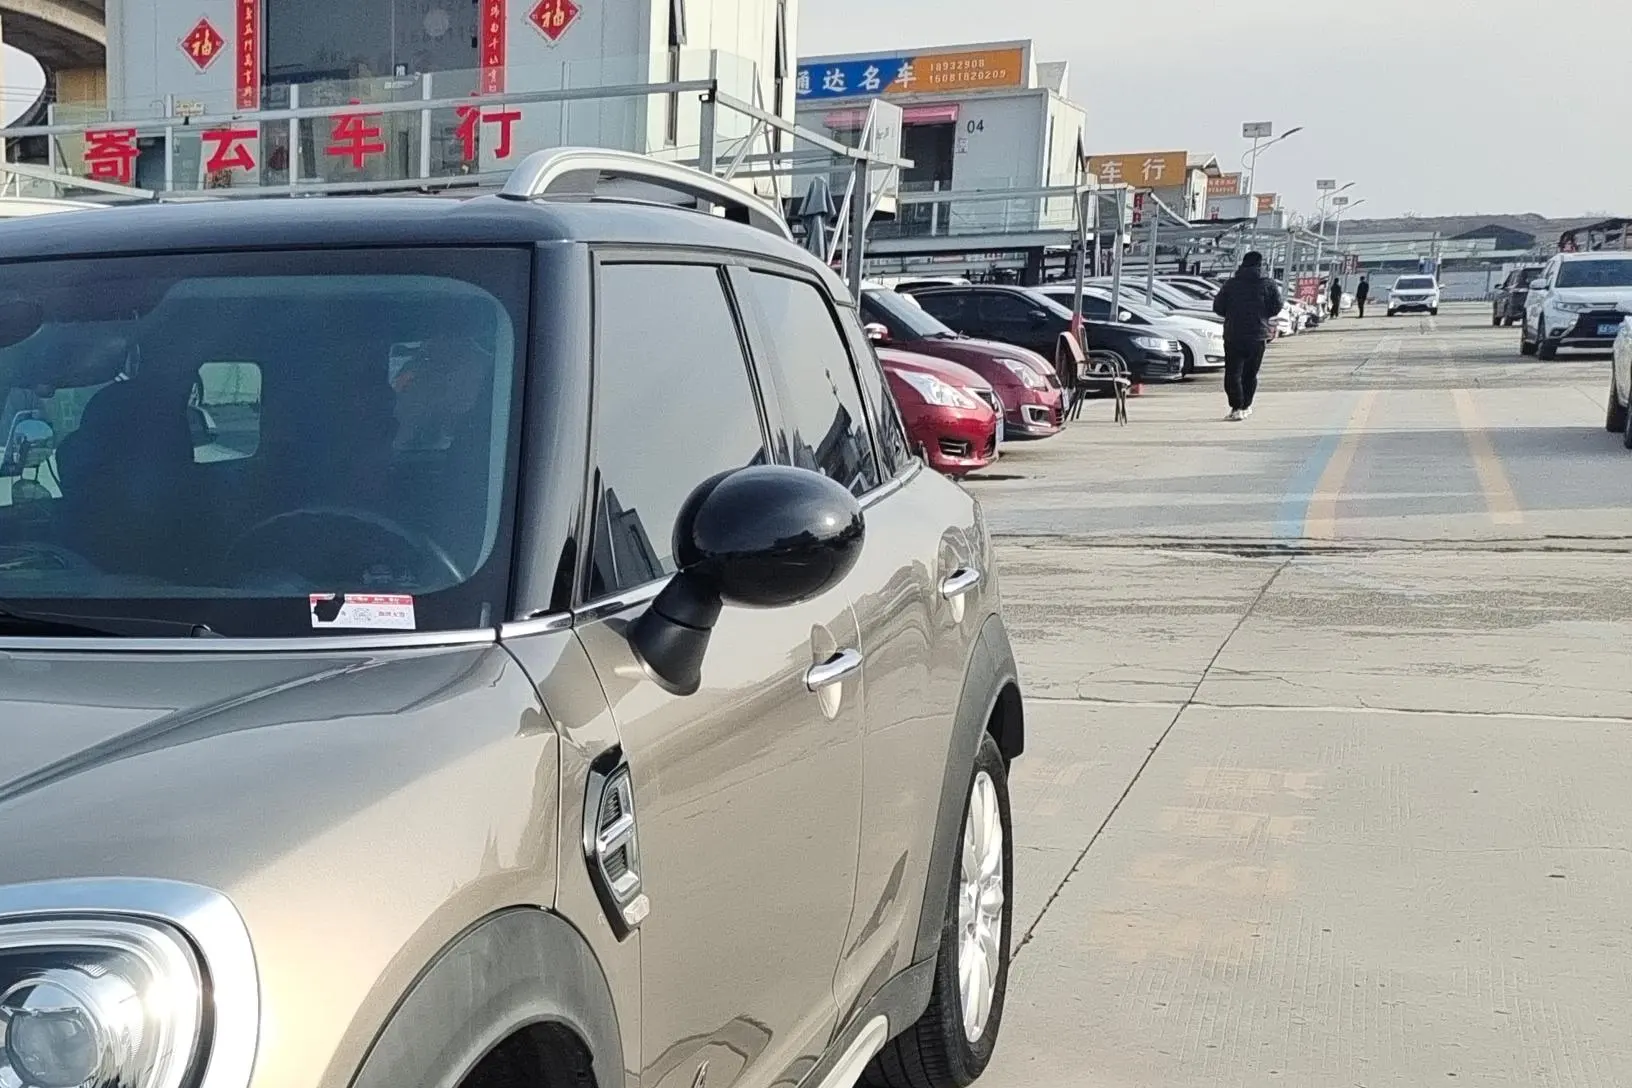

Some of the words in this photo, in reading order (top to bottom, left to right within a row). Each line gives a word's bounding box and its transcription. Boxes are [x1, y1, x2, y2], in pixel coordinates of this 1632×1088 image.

[541, 0, 565, 28] 福
[191, 29, 213, 57] 福
[796, 62, 917, 95] 通达名车
[967, 120, 984, 133] 04
